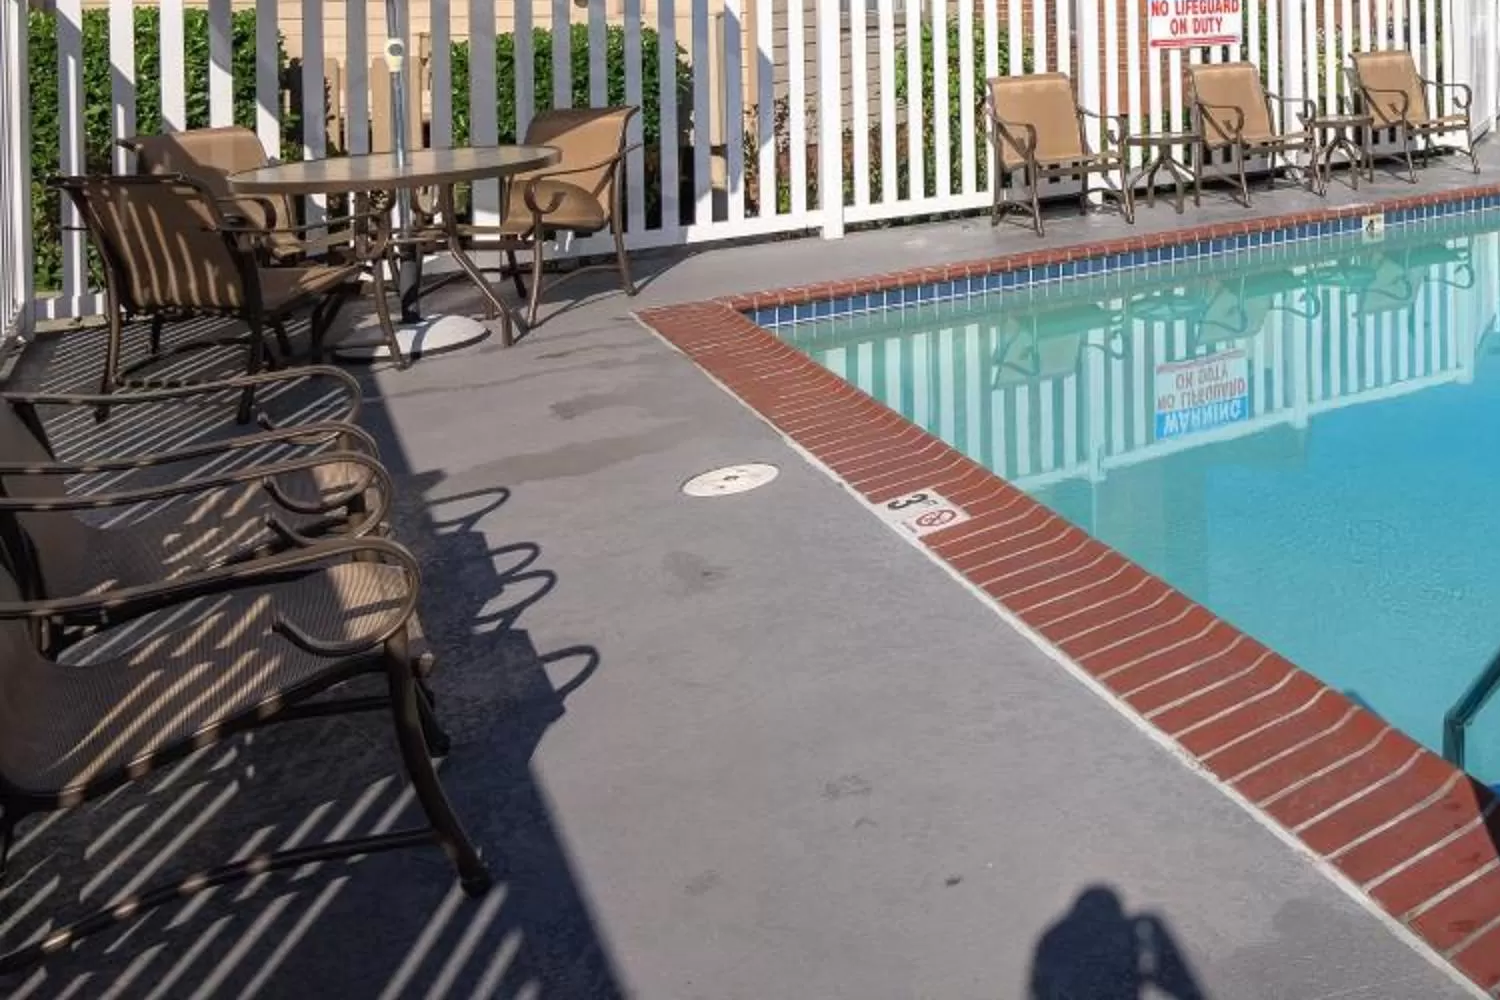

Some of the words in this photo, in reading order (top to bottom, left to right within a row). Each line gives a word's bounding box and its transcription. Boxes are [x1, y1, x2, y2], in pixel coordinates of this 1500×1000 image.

[1151, 0, 1169, 16] NO
[1170, 18, 1187, 35] ON
[1192, 17, 1223, 34] DUTY
